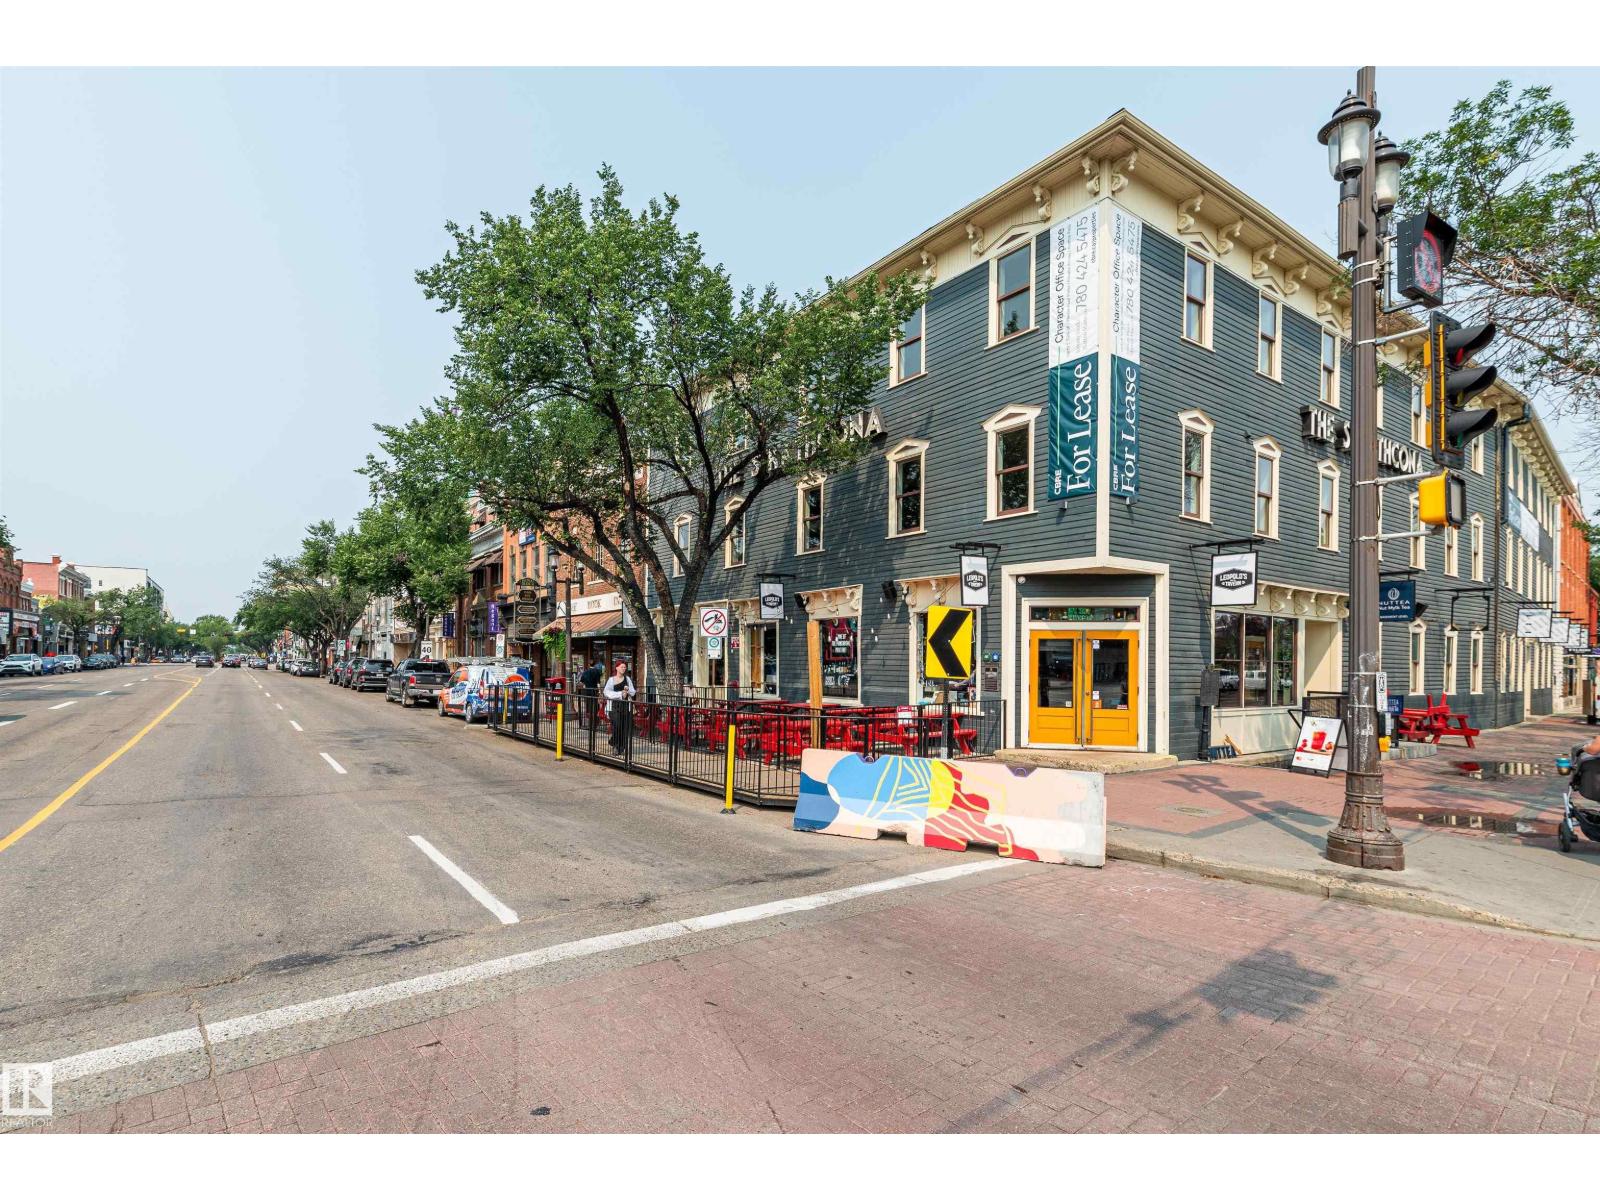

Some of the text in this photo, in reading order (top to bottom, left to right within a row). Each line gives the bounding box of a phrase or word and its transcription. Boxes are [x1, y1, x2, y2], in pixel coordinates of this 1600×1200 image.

[1076, 216, 1089, 251] 5475
[1114, 213, 1122, 247] Space
[1127, 220, 1136, 256] 5475
[1076, 255, 1088, 281] 424
[1054, 228, 1067, 344] Character Office Space
[1075, 284, 1088, 313] 780
[1126, 289, 1134, 314] 780
[1112, 282, 1120, 333] Character
[1067, 360, 1092, 443] Lease
[1121, 366, 1137, 444] Lease
[1306, 406, 1424, 474] THE STHCONA
[1054, 468, 1062, 495] CBRE
[1066, 445, 1091, 494] For
[1120, 446, 1136, 494] For
[1220, 572, 1248, 581] LEOPOLD'S
[421, 646, 432, 654] 40
